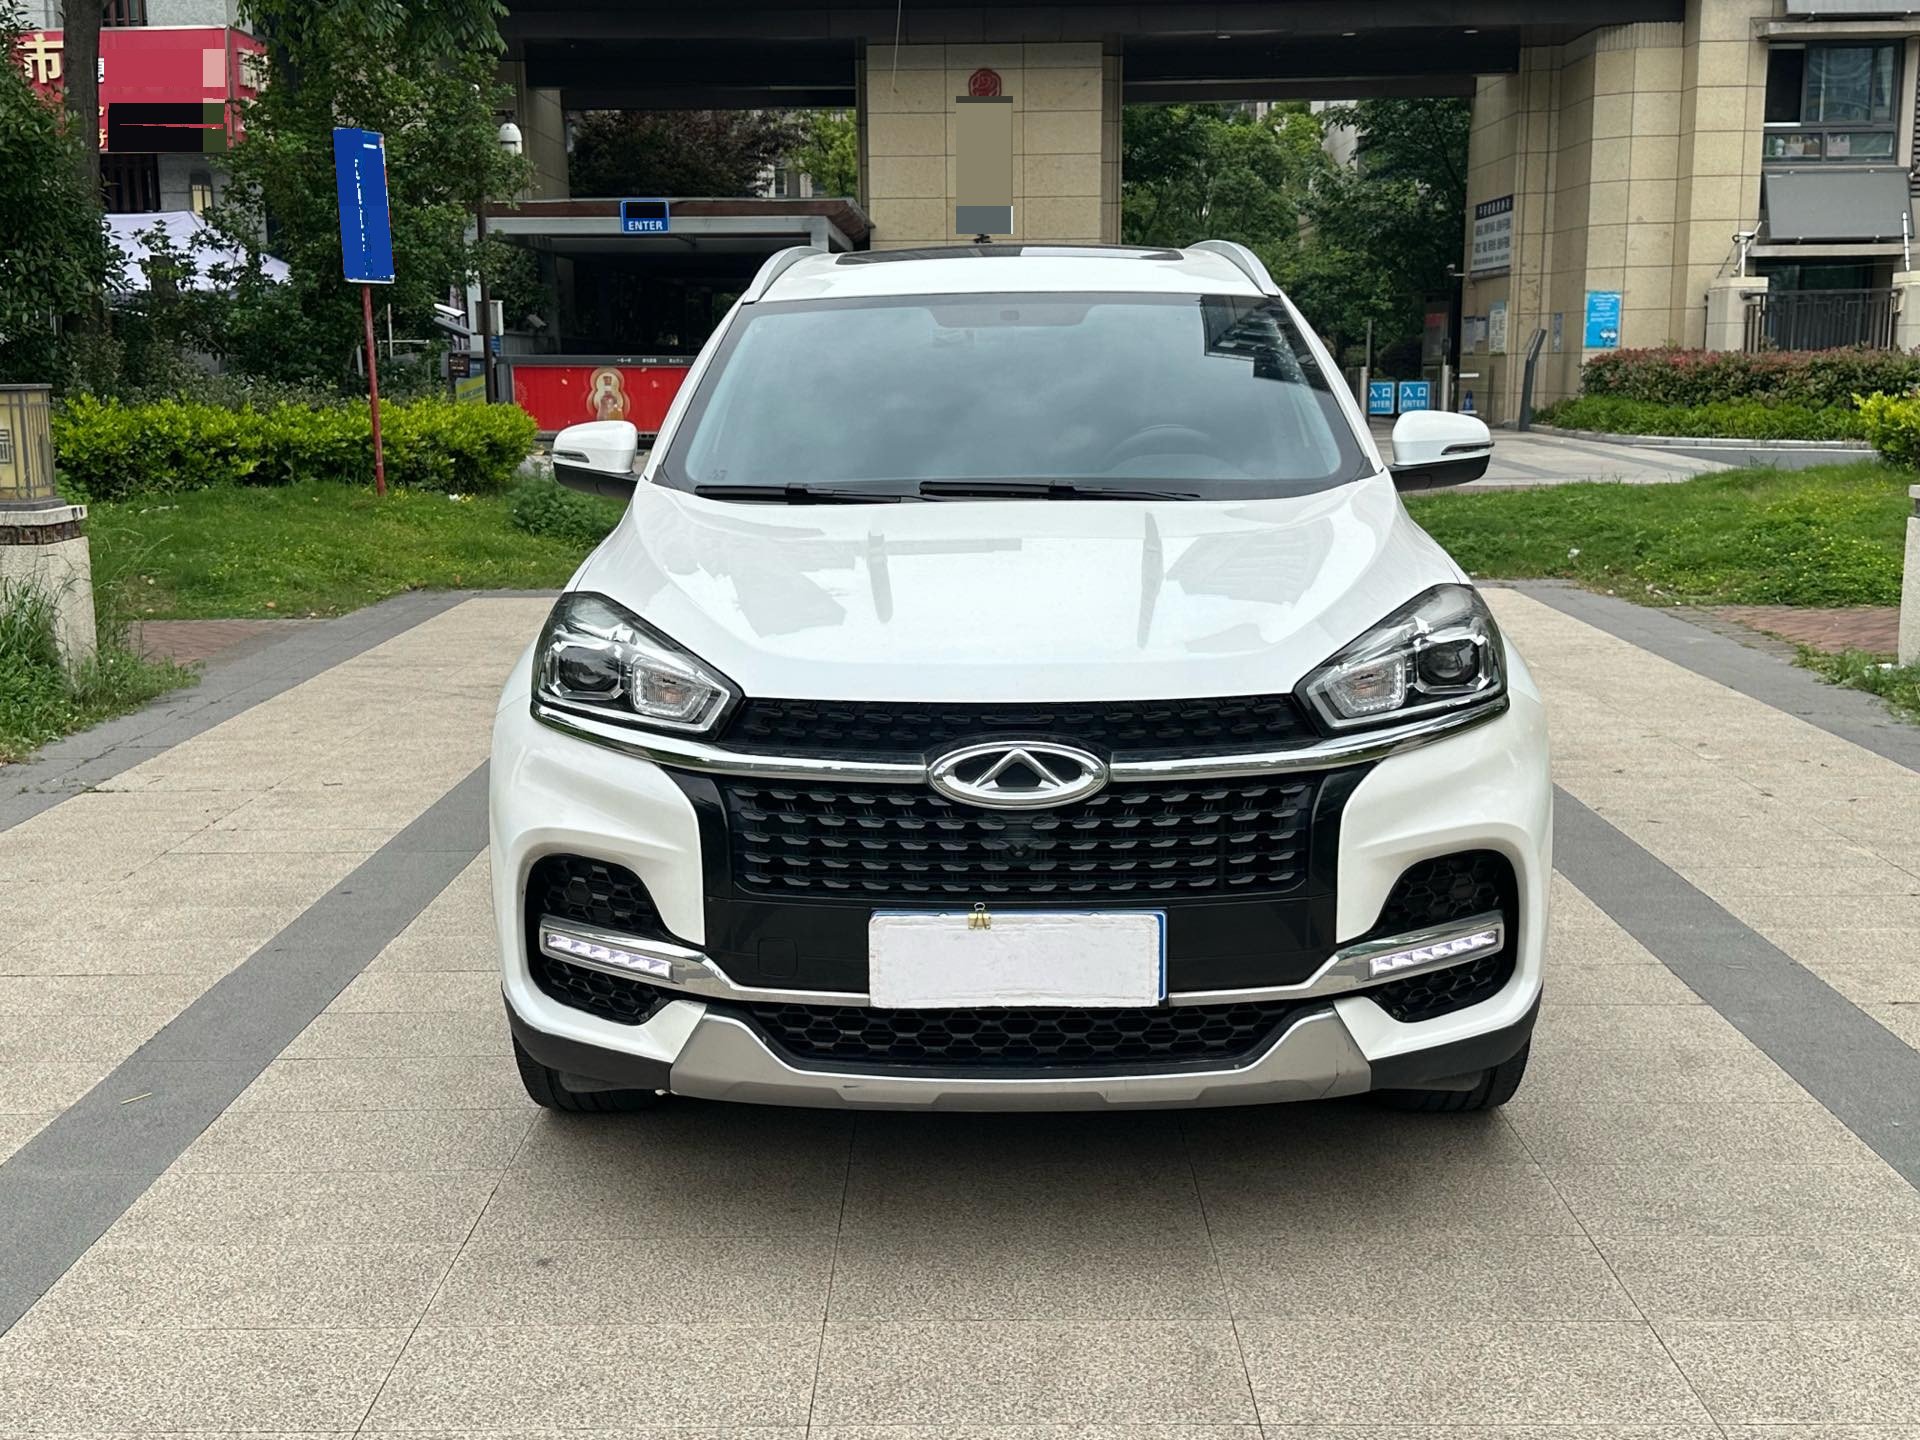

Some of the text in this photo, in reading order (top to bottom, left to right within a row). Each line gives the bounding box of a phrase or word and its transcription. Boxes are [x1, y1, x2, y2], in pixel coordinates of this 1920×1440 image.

[17, 34, 64, 84] 市
[628, 220, 663, 231] ENTER
[1369, 387, 1391, 398] 入口
[1403, 386, 1426, 398] 入口
[1402, 400, 1426, 408] ENTER
